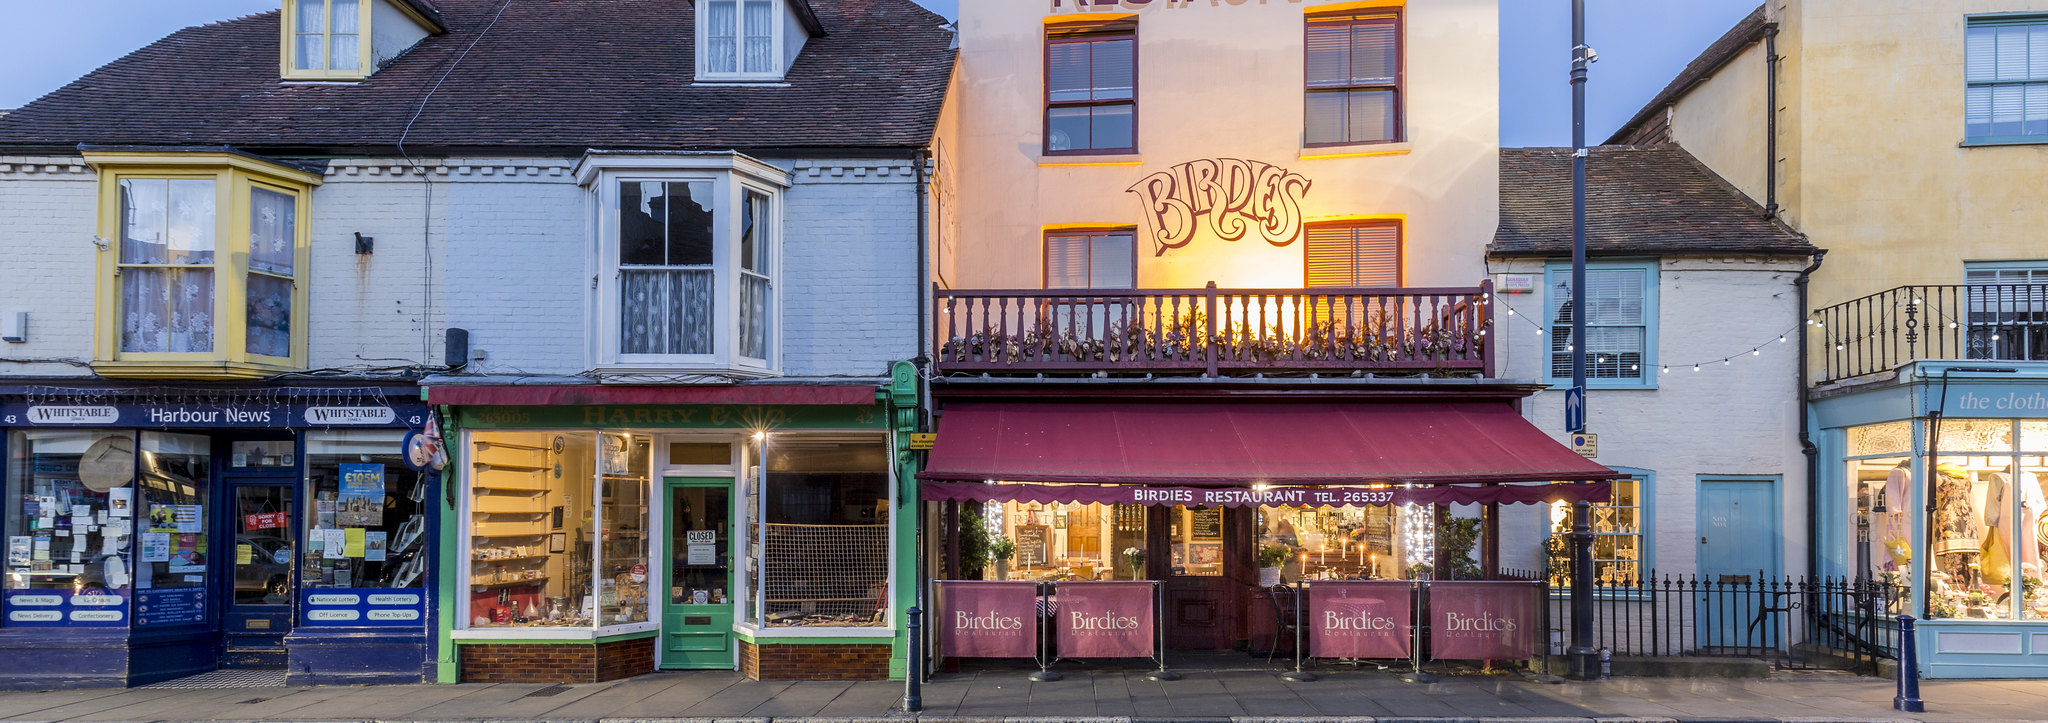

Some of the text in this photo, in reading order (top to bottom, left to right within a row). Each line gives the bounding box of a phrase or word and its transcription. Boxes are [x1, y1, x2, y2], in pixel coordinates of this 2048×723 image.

[1125, 158, 1312, 257] BIRDIES
[1960, 392, 2048, 409] the cloth
[4, 415, 17, 424] 43
[37, 408, 111, 420] WHITSTABLE
[151, 407, 271, 422] Harbour News
[314, 408, 387, 421] WHITSTABLE
[409, 416, 421, 424] 43
[584, 406, 698, 424] HARRY
[710, 406, 731, 425] &
[856, 414, 873, 424] 42
[1134, 489, 1394, 503] BIRDIES RESTAURANT TEL. 265337
[689, 531, 714, 540] CLOSED
[955, 610, 1022, 630] Birdies
[1071, 610, 1139, 631] Birdies
[1325, 610, 1395, 630] Birdies
[1446, 611, 1517, 632] Birdies
[955, 629, 1022, 637] Restaurant
